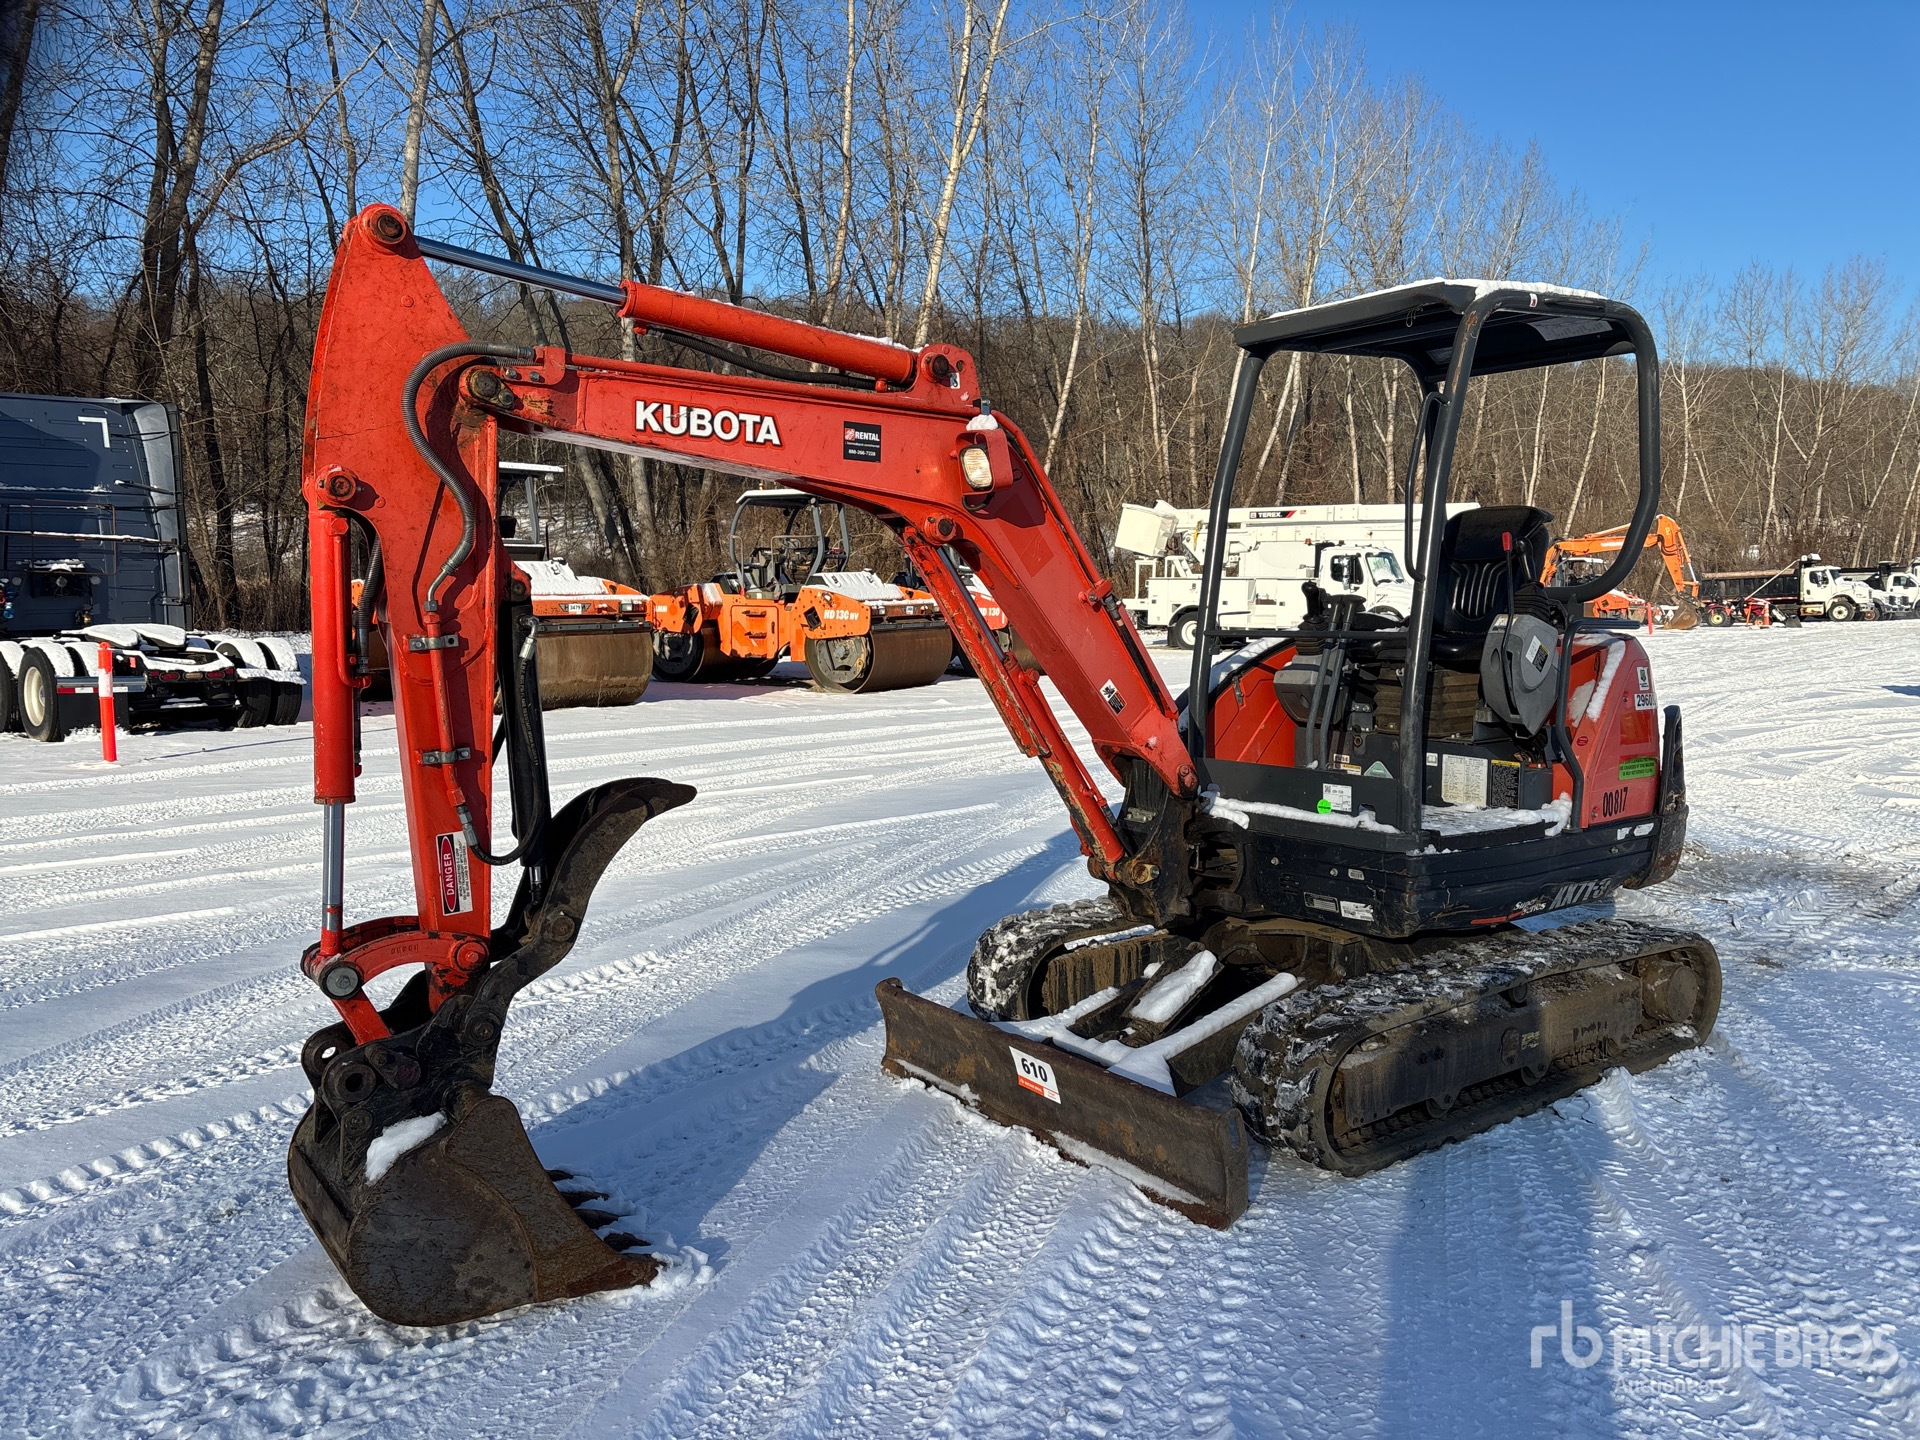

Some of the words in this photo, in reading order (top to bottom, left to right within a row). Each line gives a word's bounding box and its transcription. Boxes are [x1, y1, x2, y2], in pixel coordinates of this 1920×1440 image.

[635, 400, 782, 446] KUBOTA
[855, 431, 880, 442] RENTAL
[823, 609, 835, 619] HD
[988, 607, 1001, 616] 130
[1602, 786, 1628, 818] 00817
[443, 853, 455, 896] DANGER
[1021, 1057, 1048, 1083] 610
